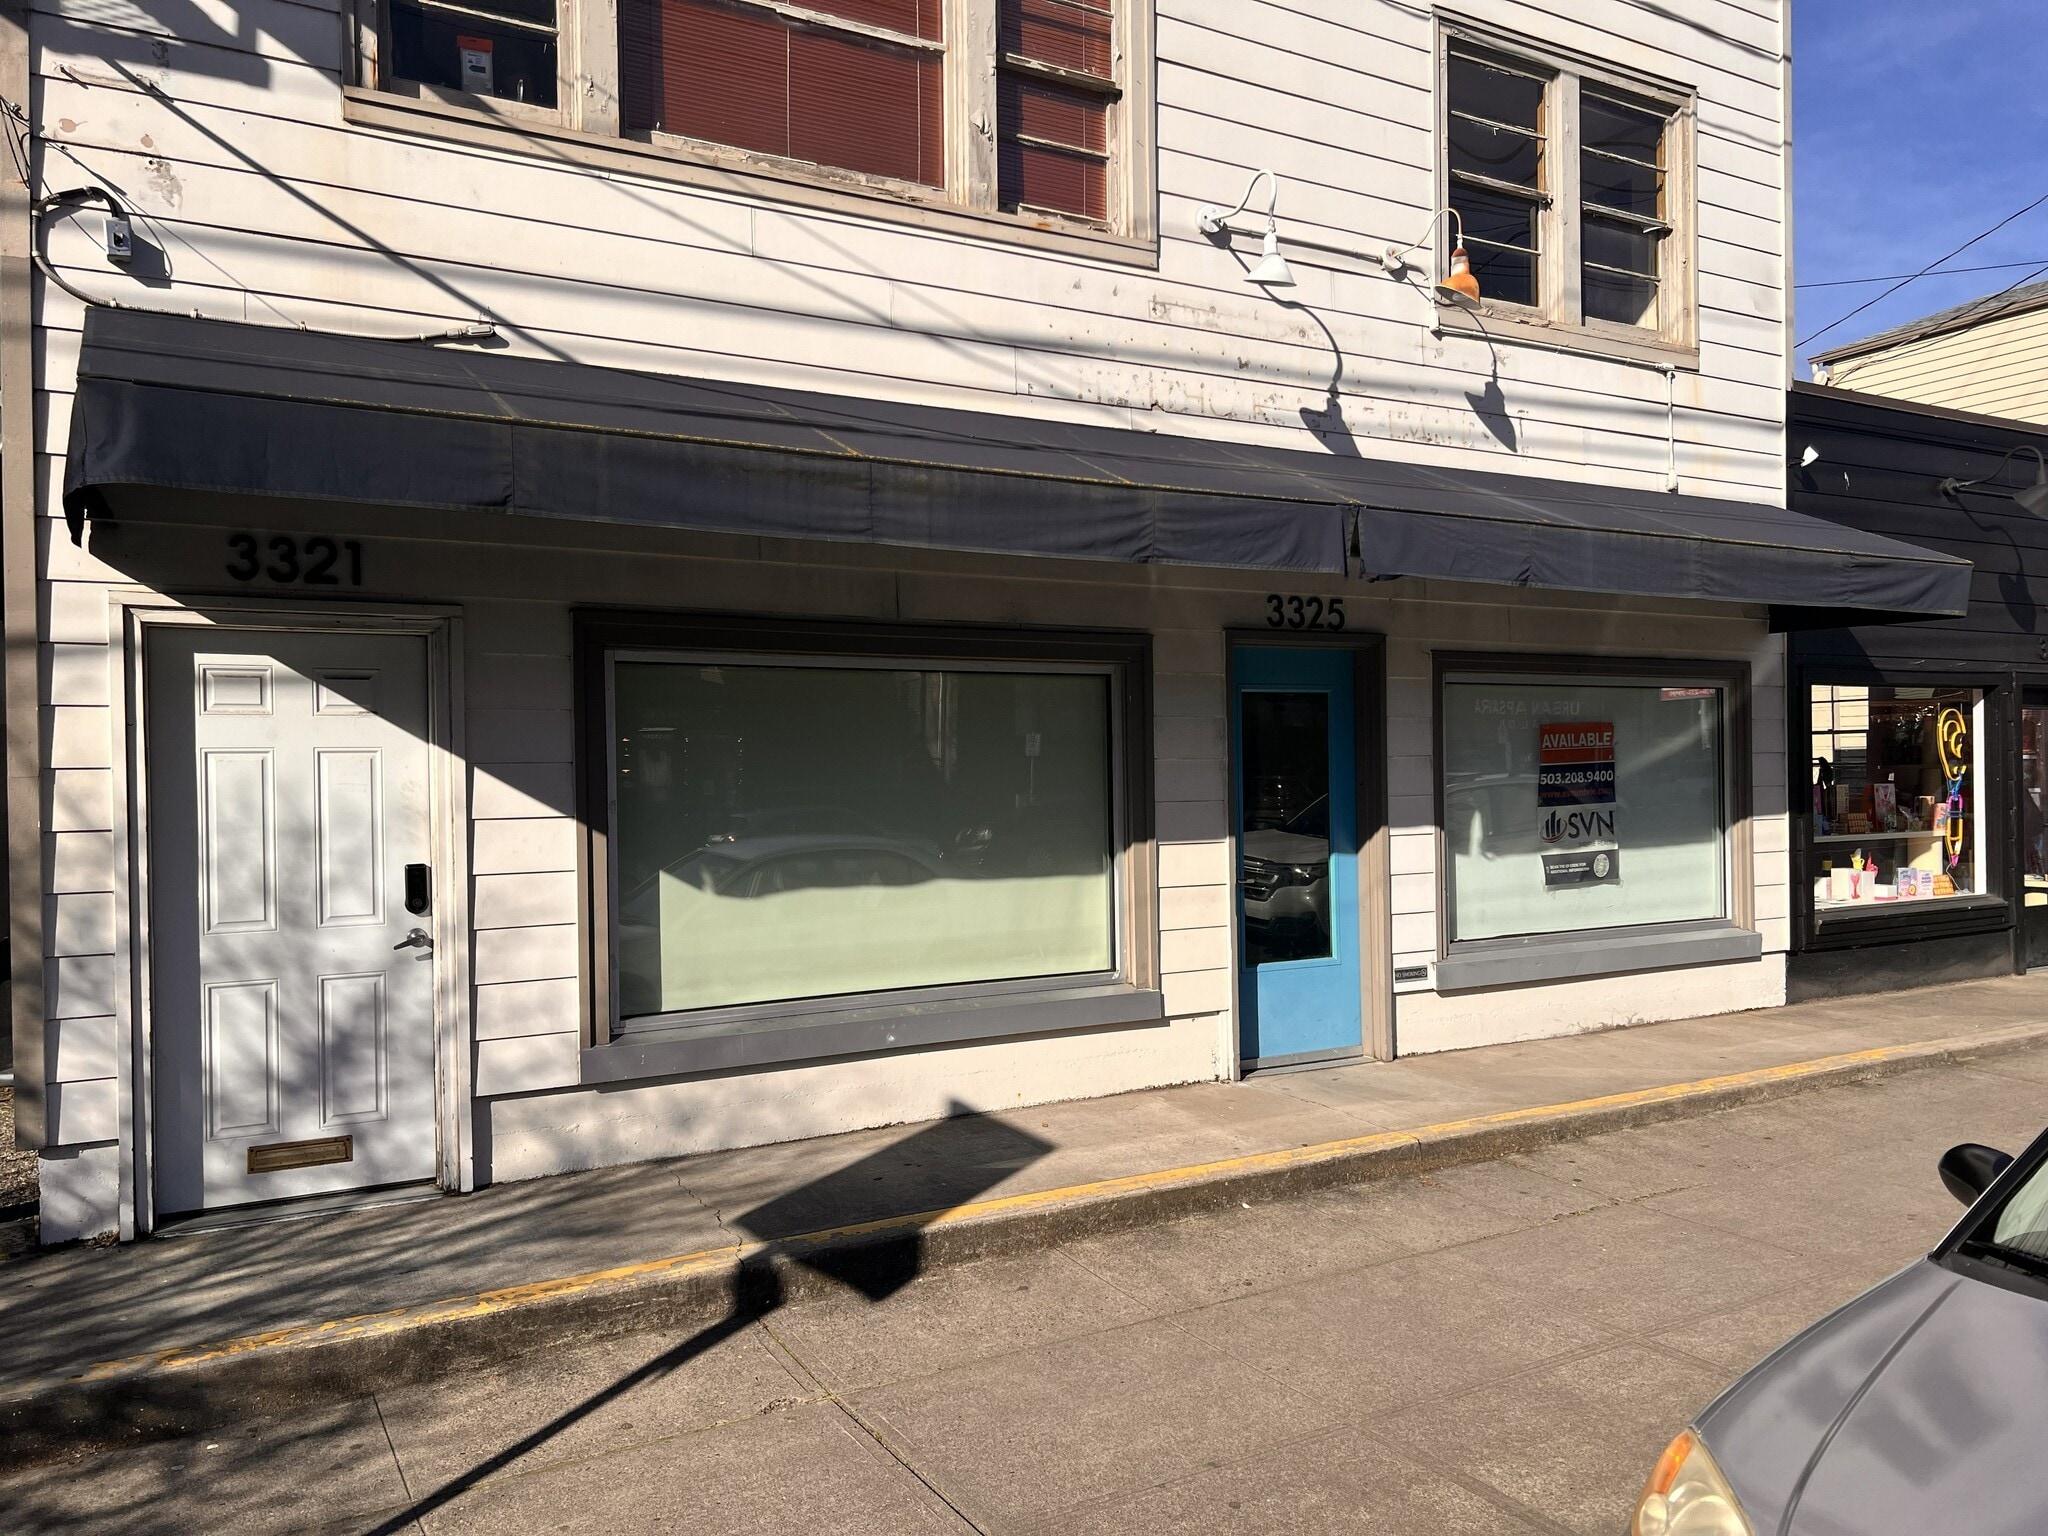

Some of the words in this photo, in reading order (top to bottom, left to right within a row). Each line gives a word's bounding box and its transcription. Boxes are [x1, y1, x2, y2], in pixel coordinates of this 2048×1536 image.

[226, 534, 361, 586] 3321
[1266, 594, 1345, 631] 3325
[1542, 732, 1612, 748] AVAILABLE
[1540, 770, 1613, 785] 503.208.9400
[1568, 810, 1615, 839] SVN
